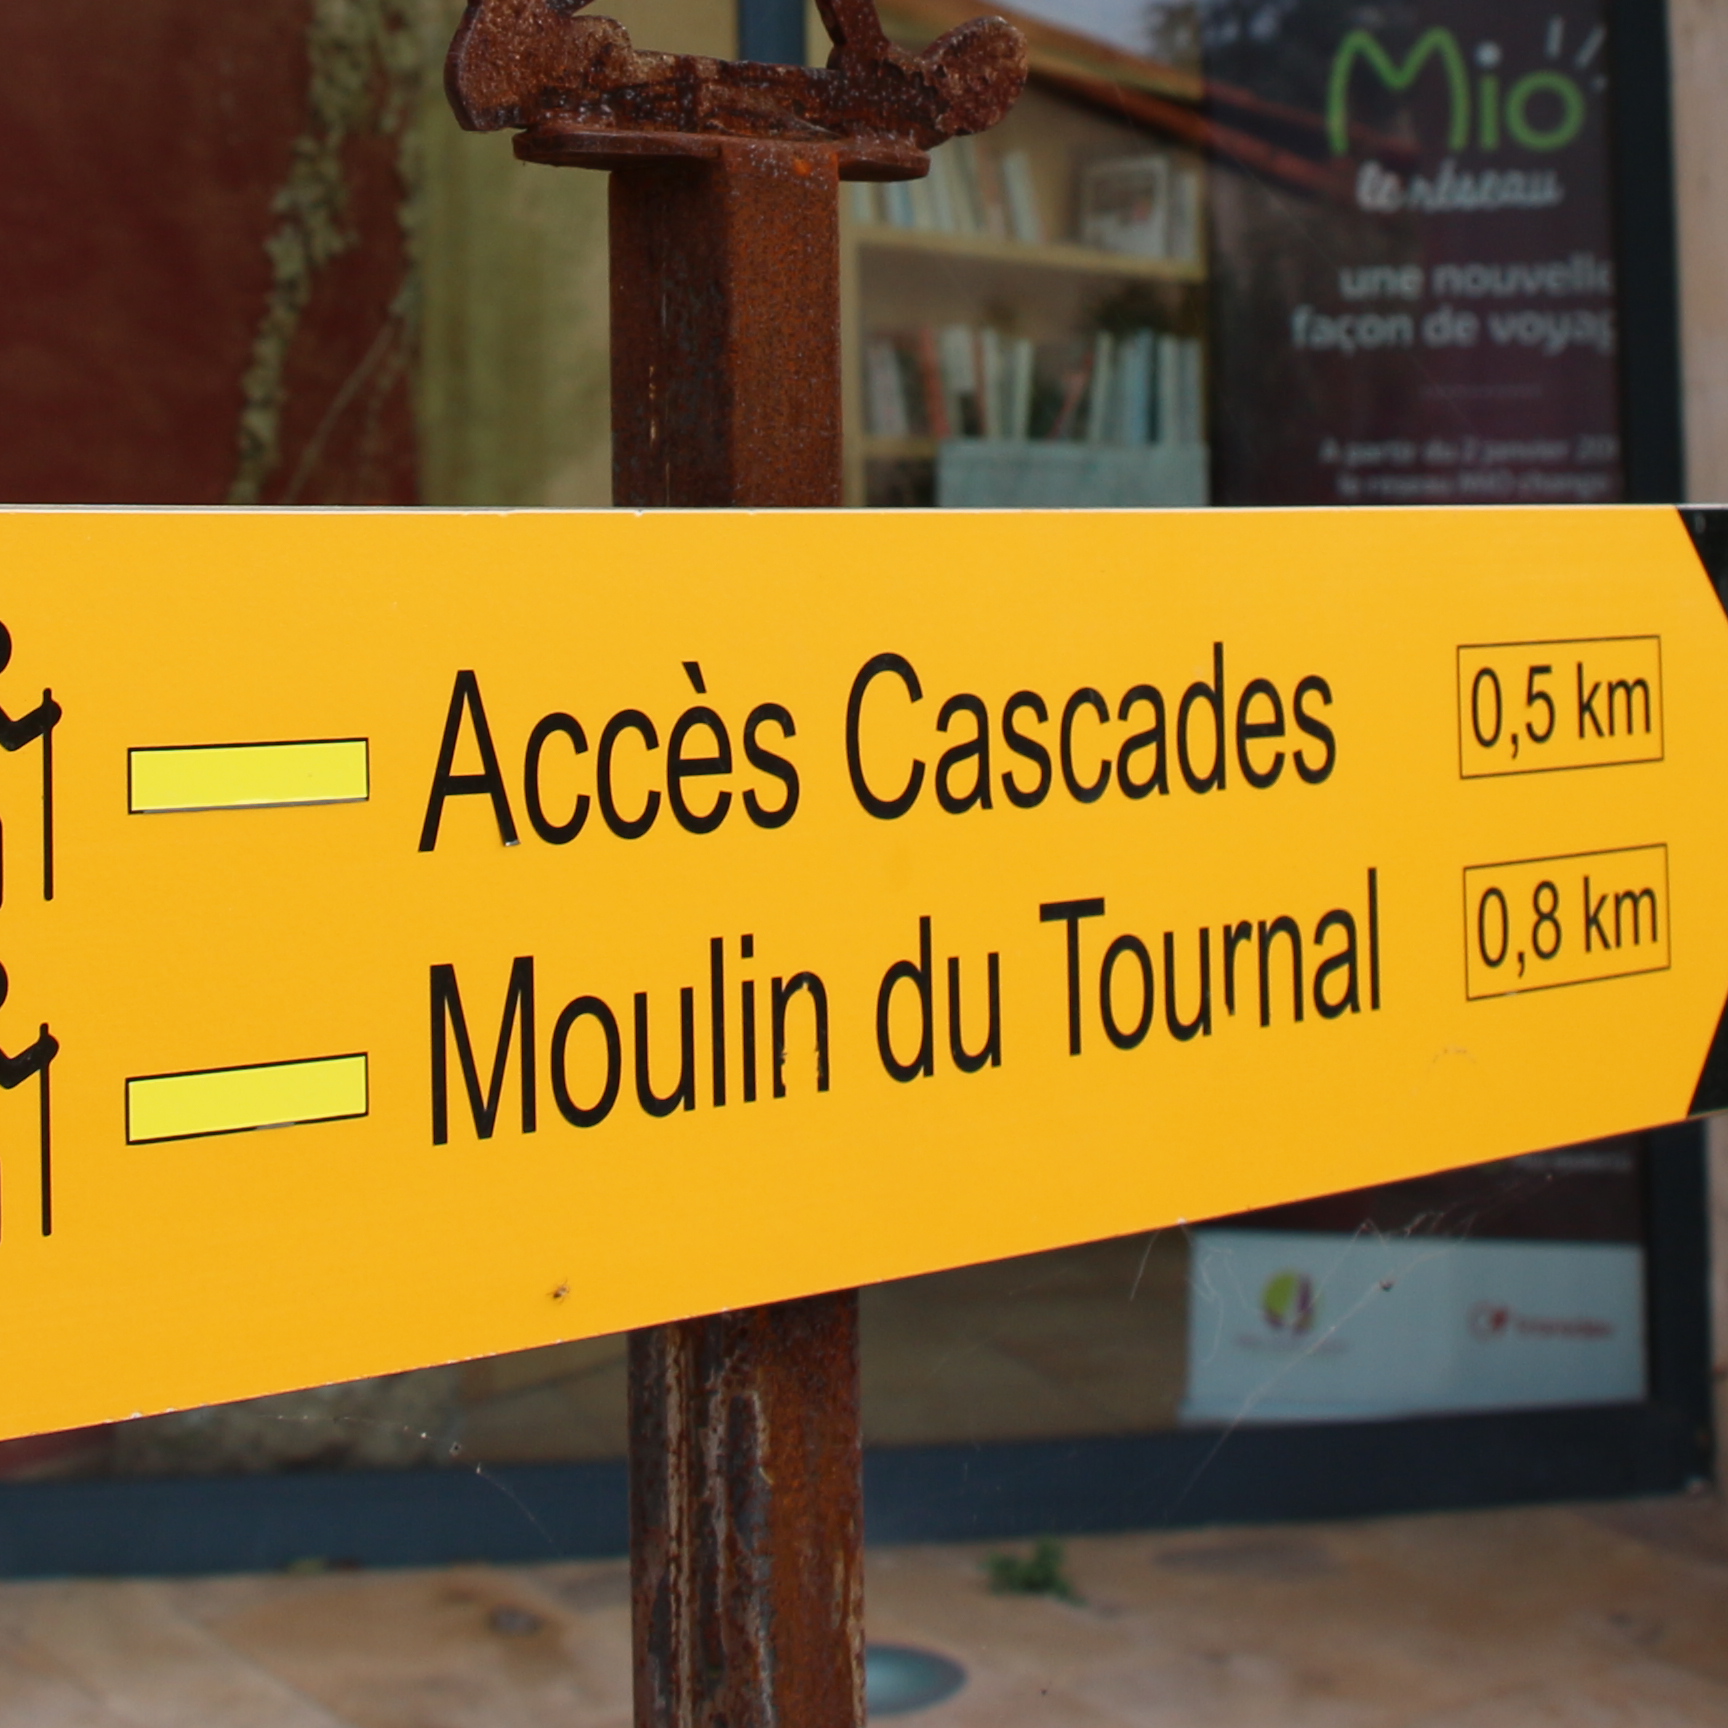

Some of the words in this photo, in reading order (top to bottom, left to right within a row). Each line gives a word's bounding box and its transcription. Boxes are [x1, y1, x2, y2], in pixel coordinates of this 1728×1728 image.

[1328, 26, 1585, 155] Mio
[1357, 160, 1403, 212] le
[1291, 305, 1414, 353] façon
[1422, 303, 1481, 347] de
[1339, 263, 1423, 300] une
[418, 661, 800, 853] Accès
[846, 642, 1337, 820] Cascades
[1471, 665, 1555, 759] 0,5
[1577, 662, 1651, 738] km
[1478, 880, 1562, 978] 0,8
[1583, 875, 1658, 952] km
[430, 934, 830, 1147] Moulin
[876, 916, 1002, 1083] du
[1039, 868, 1381, 1056] Tournal
